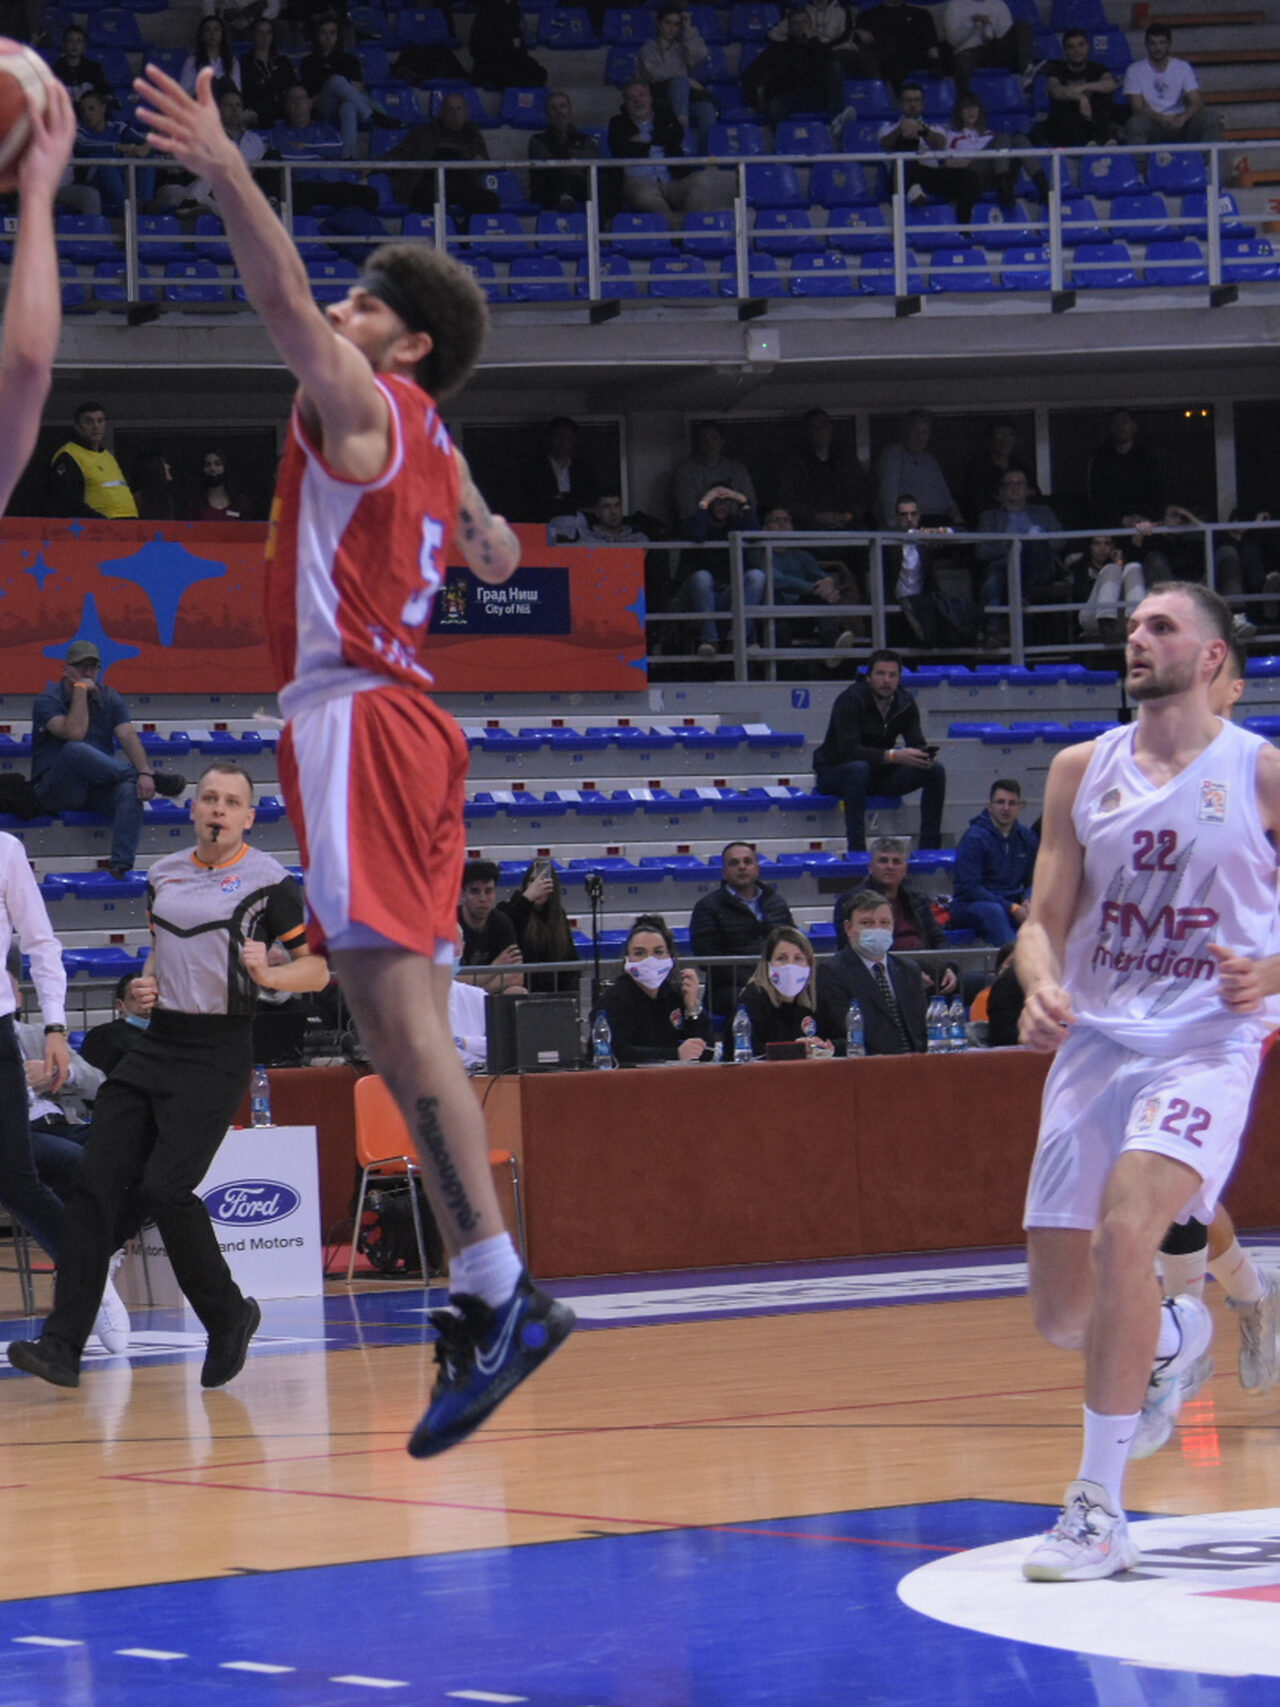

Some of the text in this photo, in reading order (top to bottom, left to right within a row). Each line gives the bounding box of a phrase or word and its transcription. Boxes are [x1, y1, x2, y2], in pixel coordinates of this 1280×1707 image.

[401, 512, 444, 628] 5
[477, 587, 538, 604] Град Ниш
[485, 604, 504, 616] City
[505, 603, 515, 614] of
[795, 690, 806, 708] 7
[1133, 829, 1178, 872] 22
[1099, 900, 1219, 941] FMP
[1091, 944, 1216, 980] meridian
[1160, 1098, 1212, 1148] 22
[218, 1187, 281, 1219] Ford
[218, 1236, 305, 1253] and Motors
